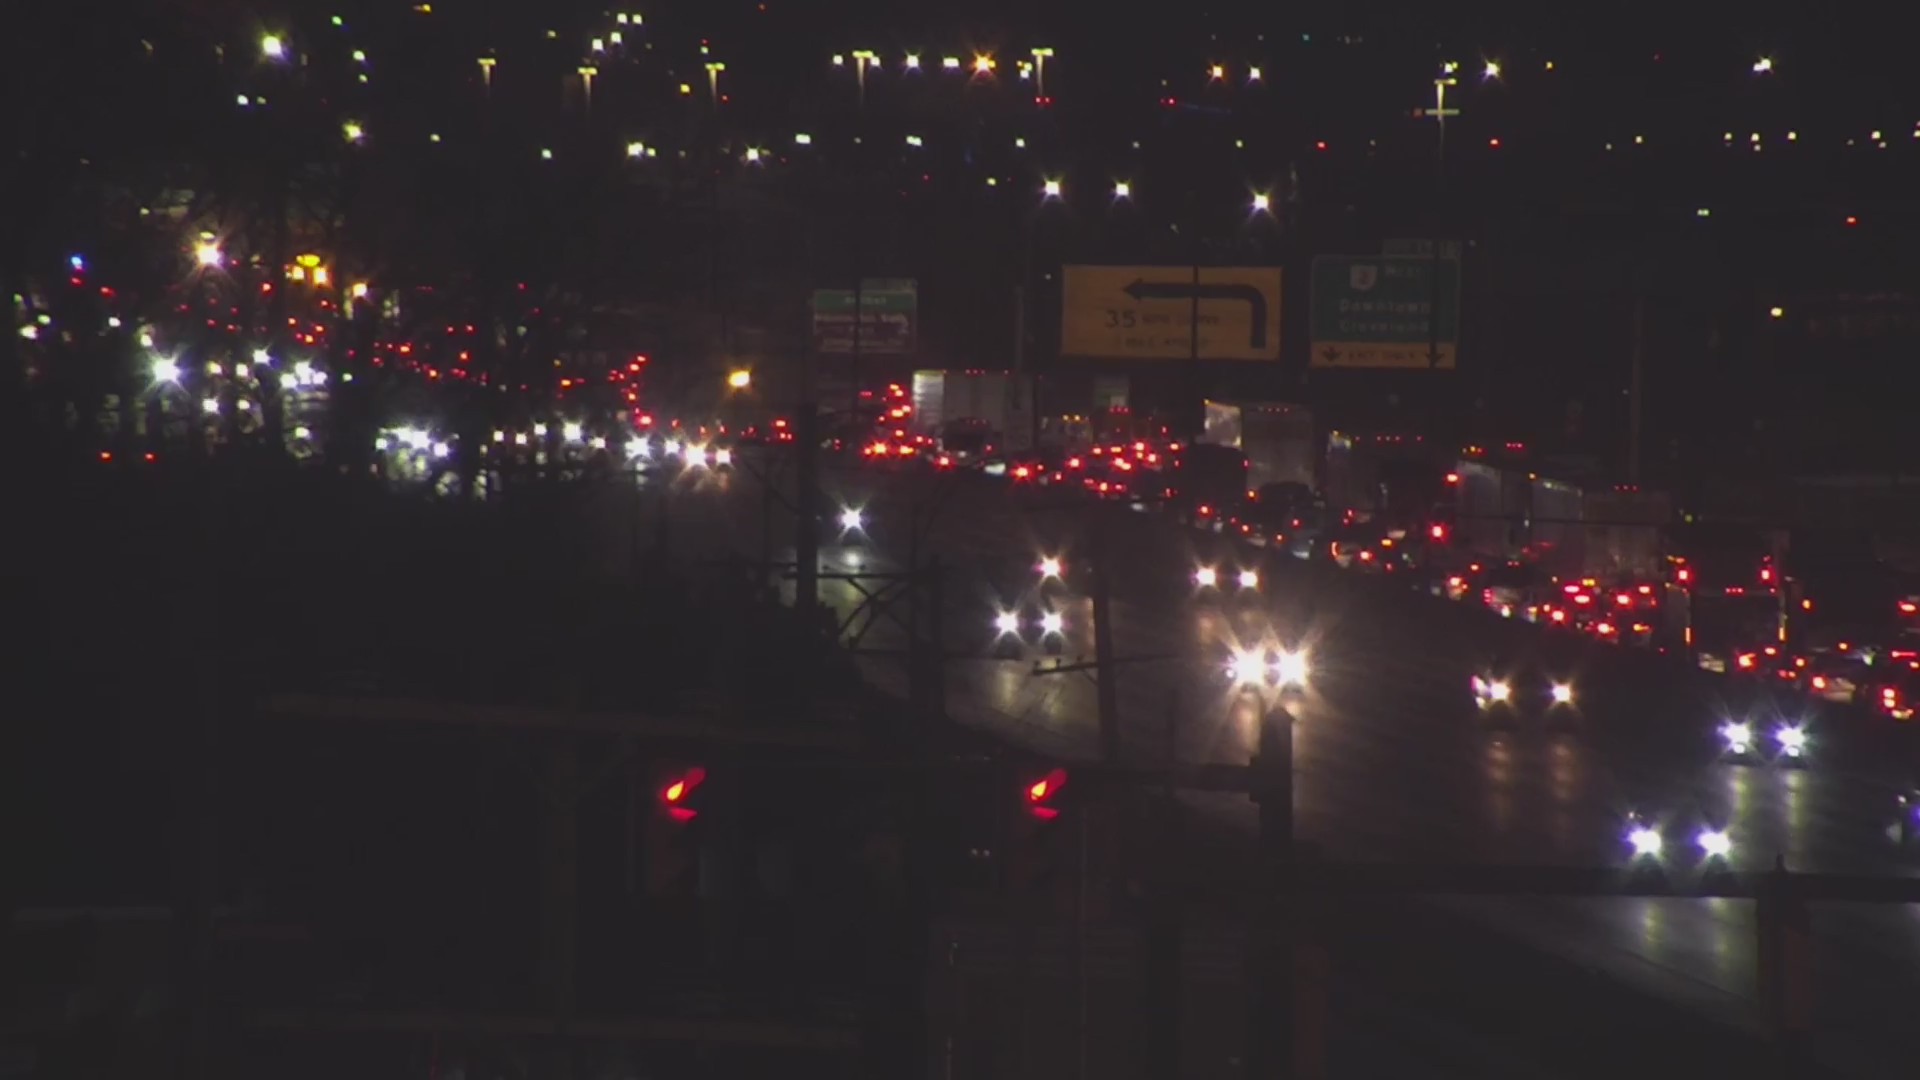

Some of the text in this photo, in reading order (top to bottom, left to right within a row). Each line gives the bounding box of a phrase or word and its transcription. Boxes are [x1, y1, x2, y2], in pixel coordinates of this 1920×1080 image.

[1339, 298, 1431, 314] Downtown
[1104, 309, 1136, 328] 35
[1339, 319, 1429, 334] Cleveland
